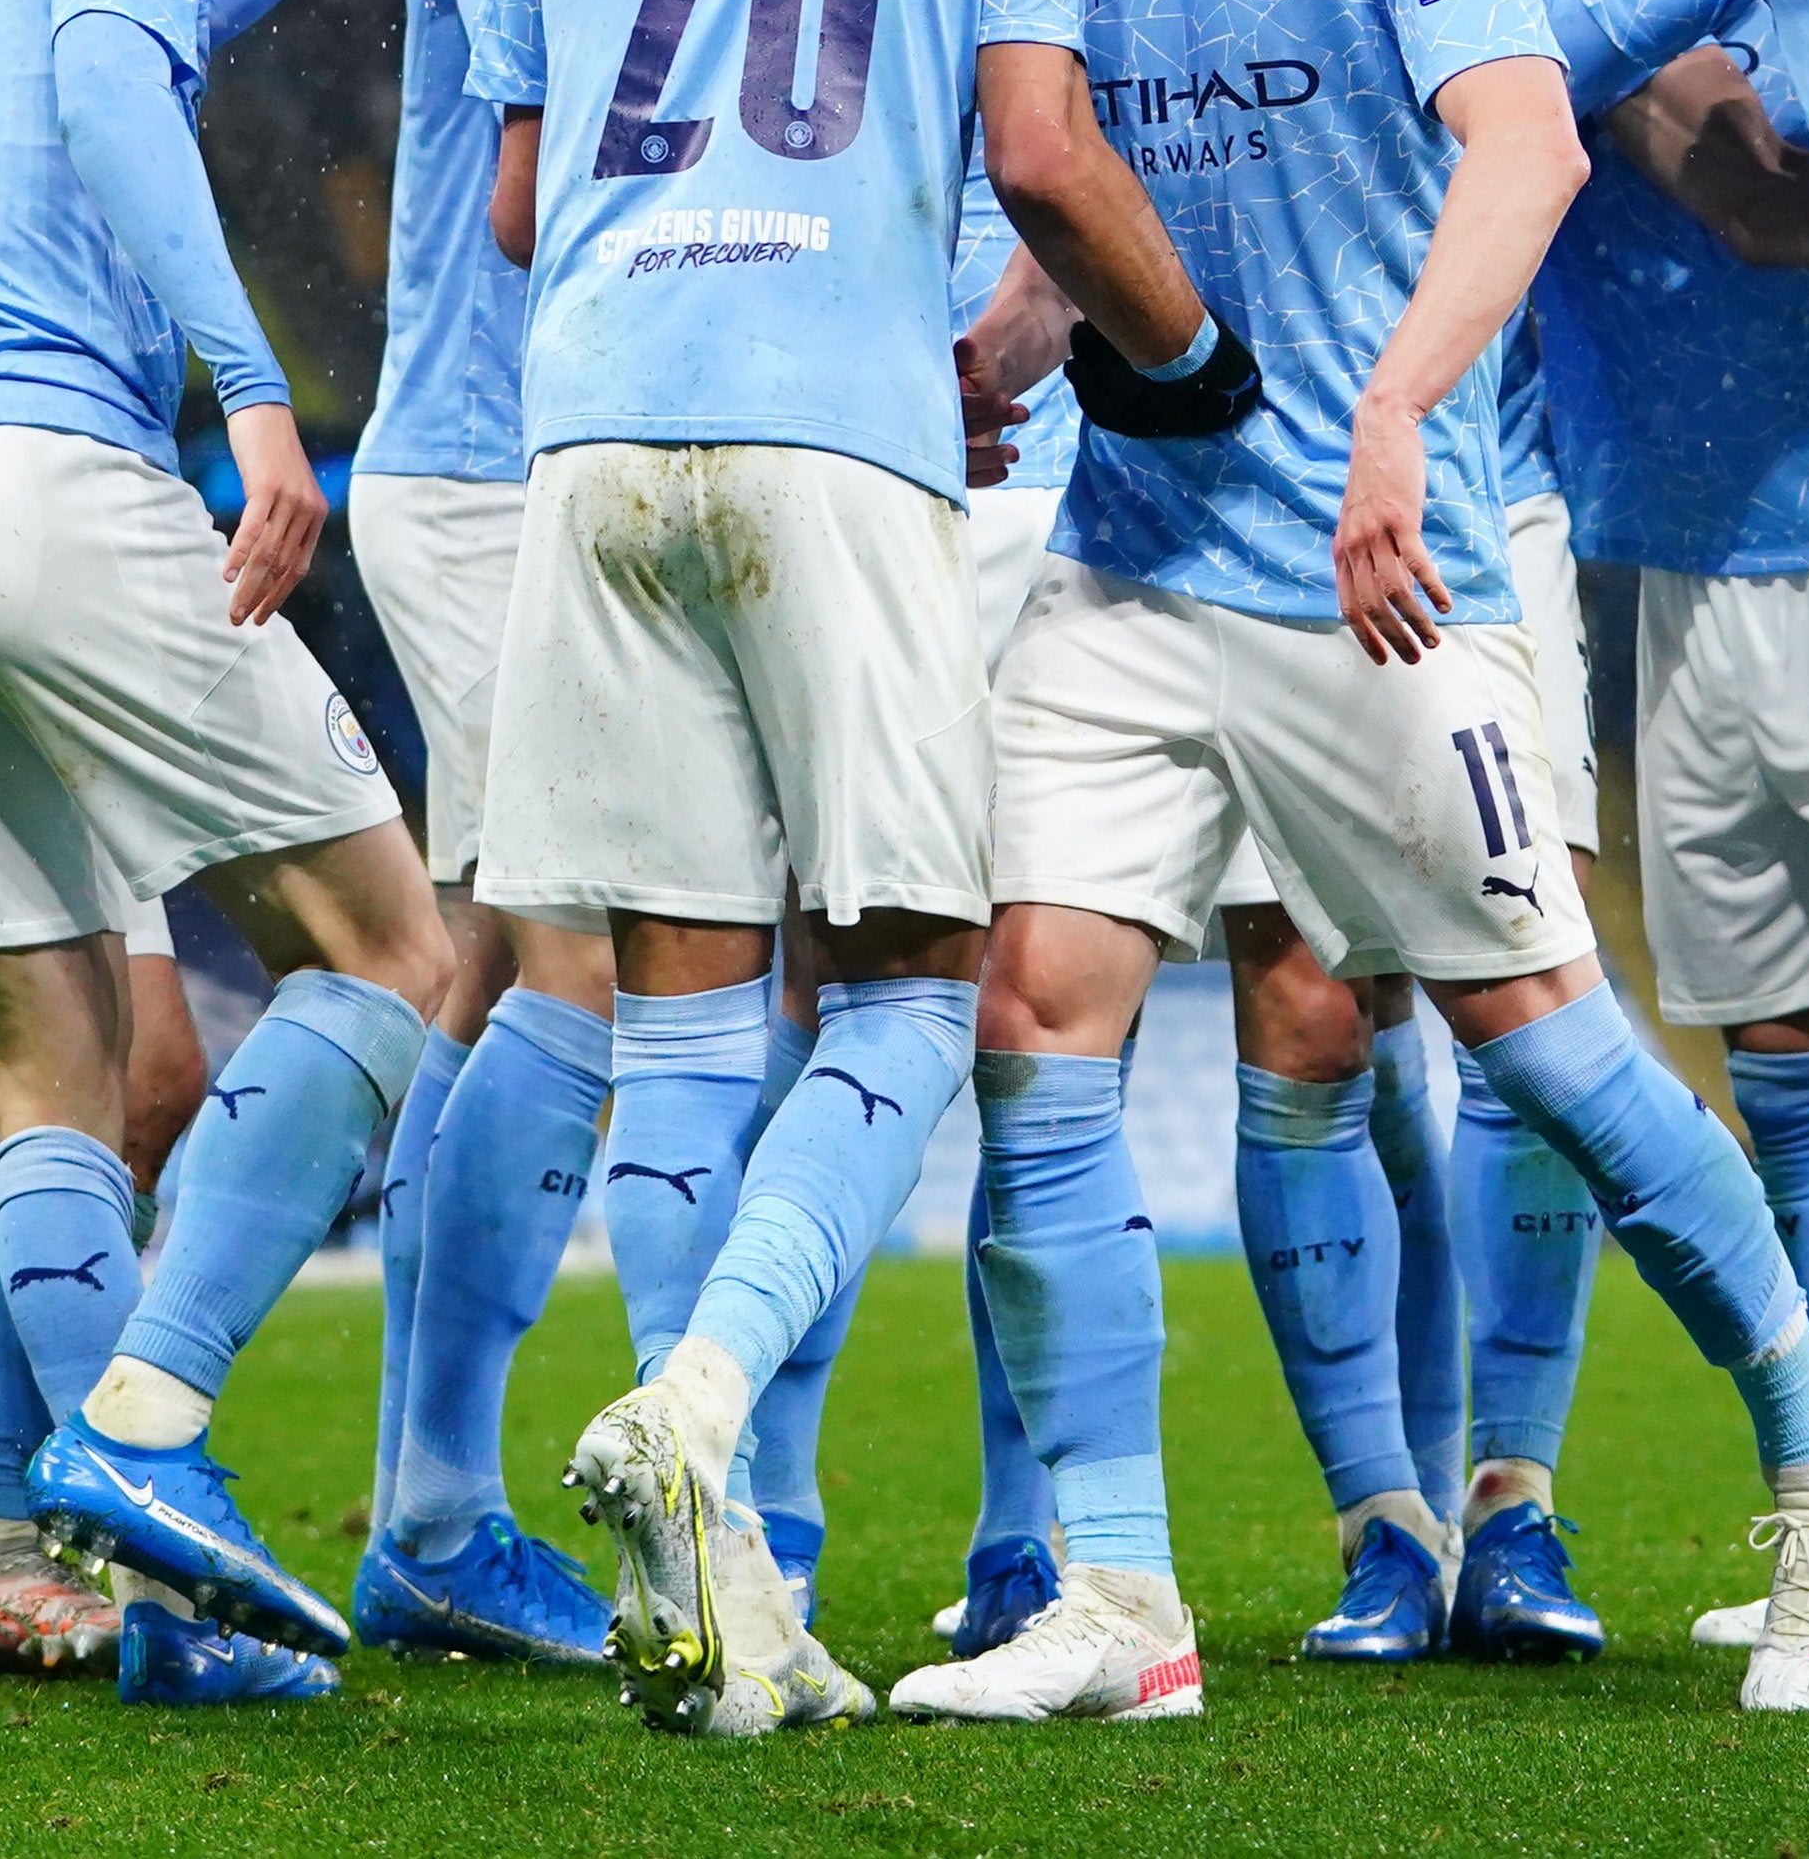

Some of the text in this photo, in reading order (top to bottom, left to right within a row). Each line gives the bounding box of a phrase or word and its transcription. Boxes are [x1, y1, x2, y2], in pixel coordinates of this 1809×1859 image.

[1127, 130, 1268, 175] IRWAYS
[596, 208, 831, 264] CITZENS GIVING
[627, 241, 802, 279] FOR RECOVERY
[1451, 721, 1532, 858] 11
[539, 1168, 588, 1200] CIT
[1512, 1211, 1598, 1233] CITY
[1270, 1237, 1365, 1270] CITY
